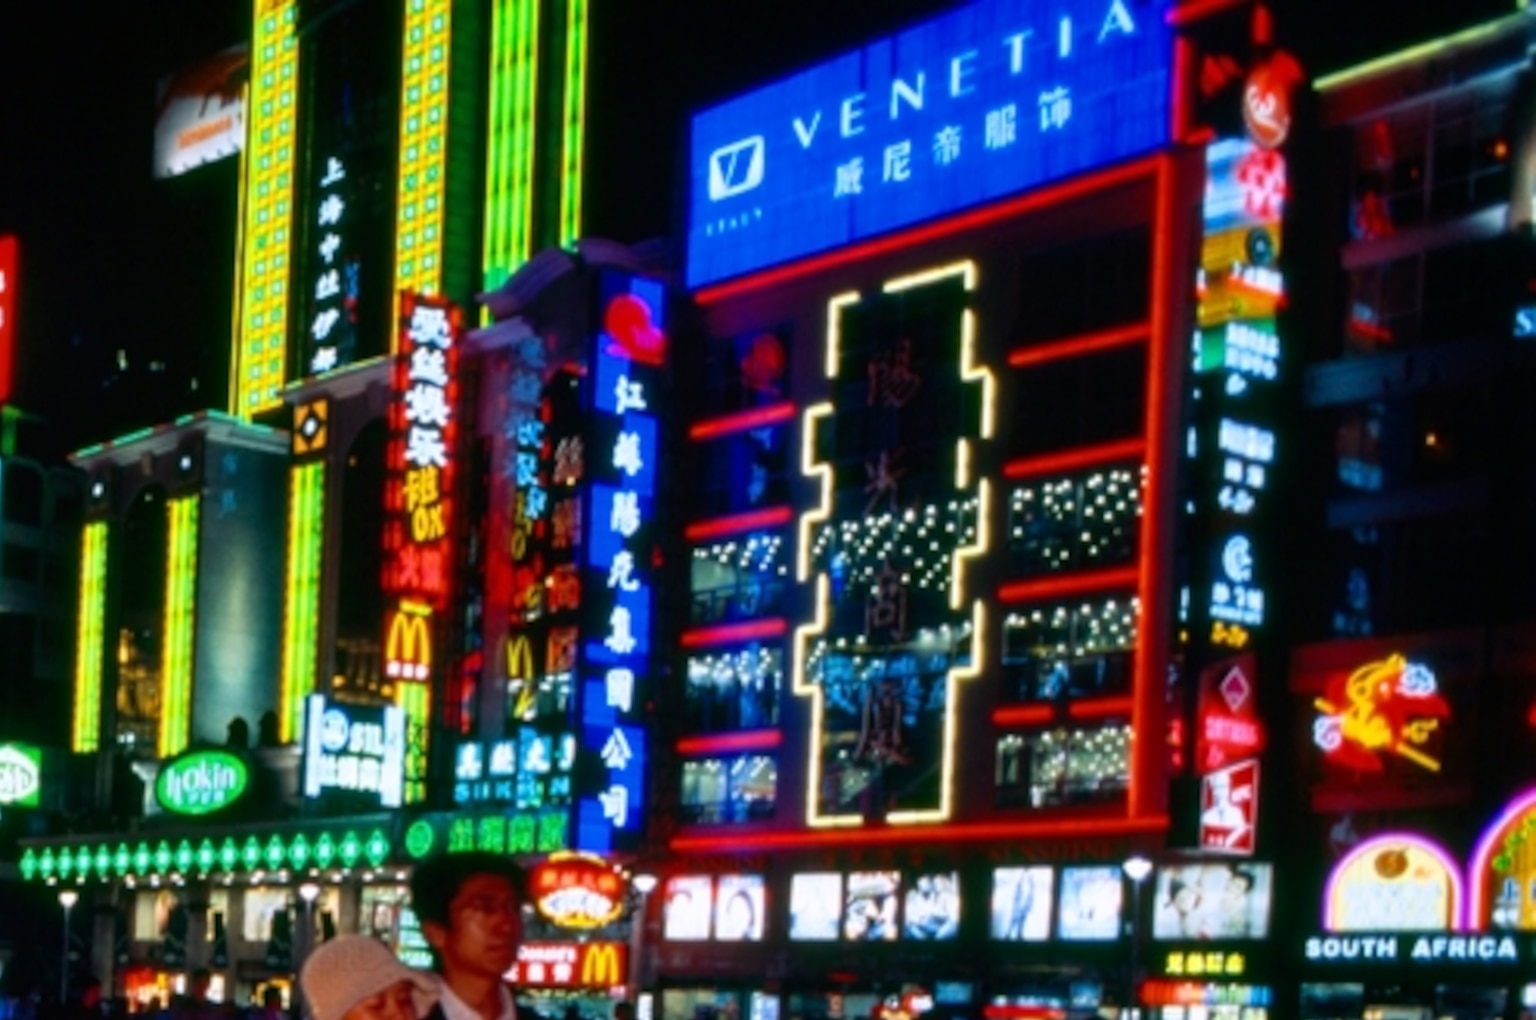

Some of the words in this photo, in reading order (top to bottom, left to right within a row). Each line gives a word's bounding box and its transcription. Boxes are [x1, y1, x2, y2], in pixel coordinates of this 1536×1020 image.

[792, 0, 1135, 148] VENETIA
[834, 85, 1072, 198] 威尼帝服饰
[1305, 937, 1397, 958] SOUTH
[1411, 937, 1517, 958] AFRICA
